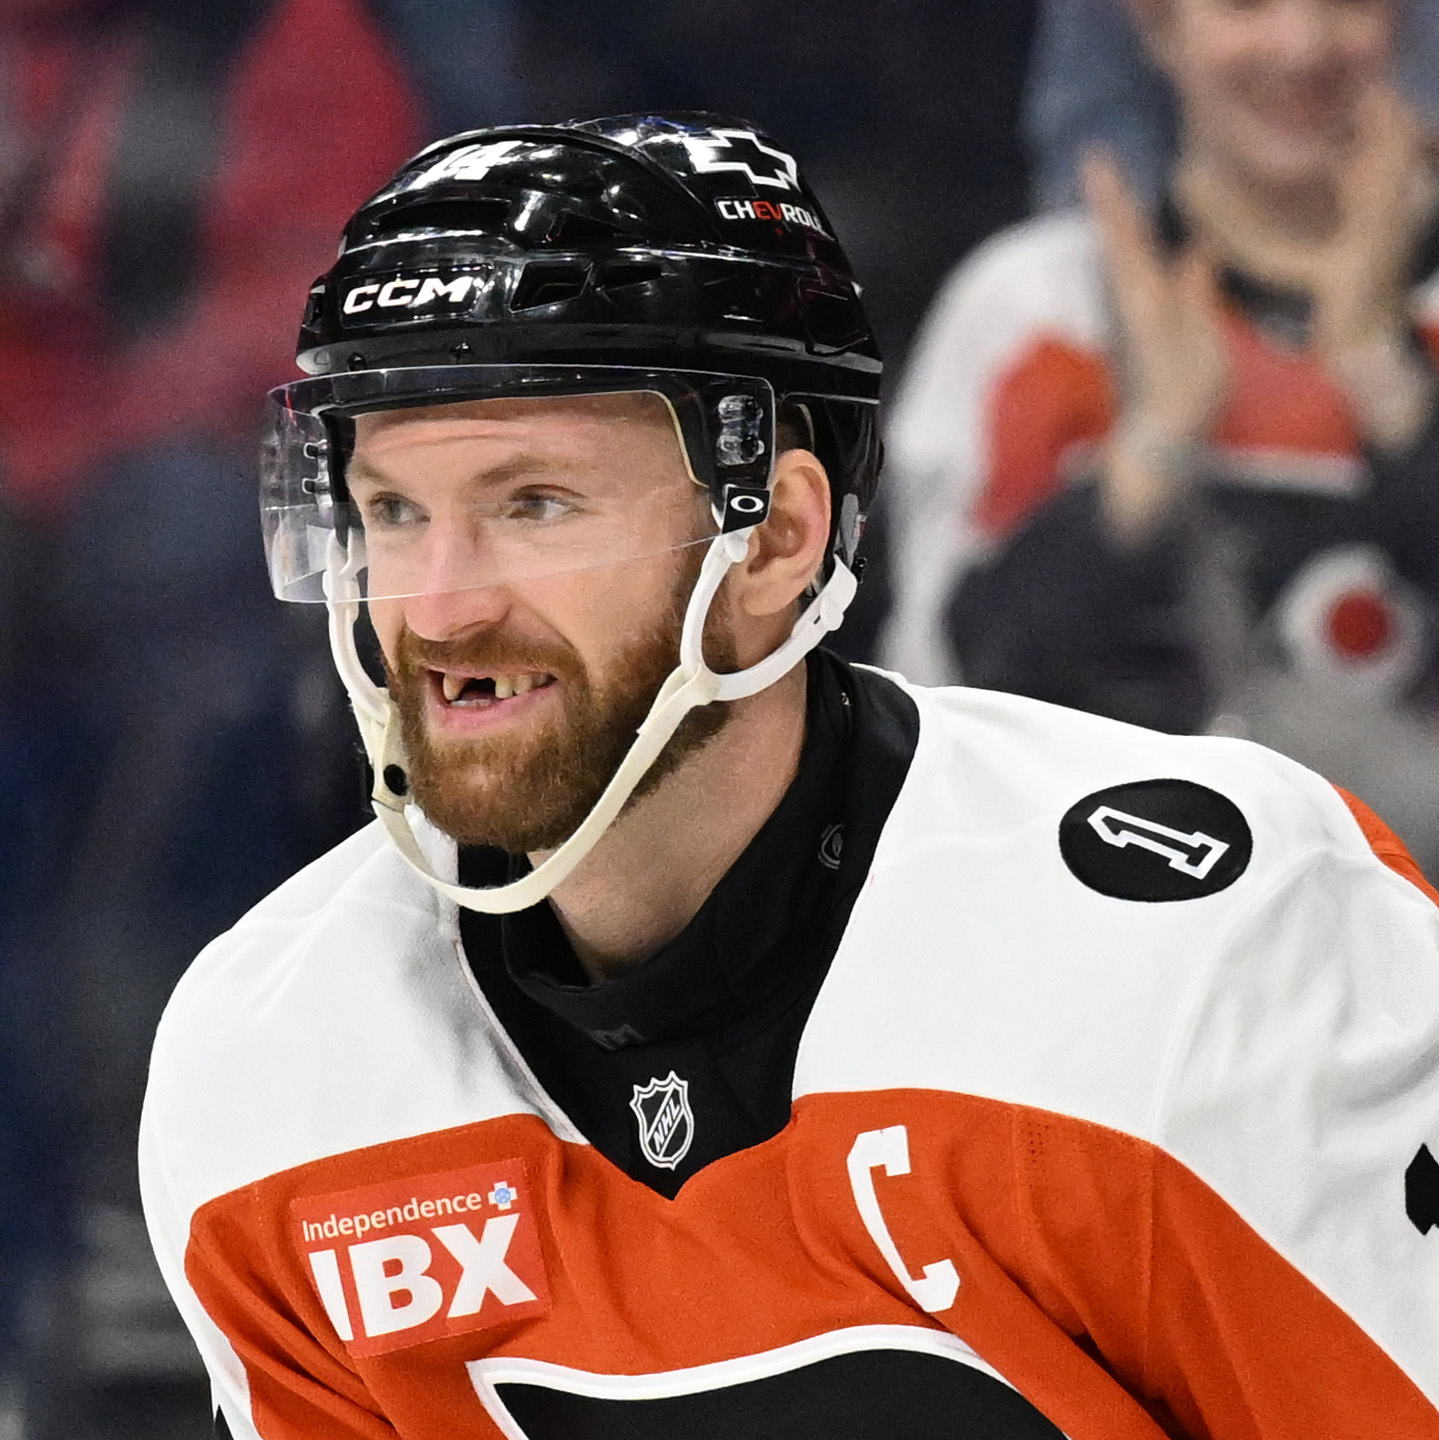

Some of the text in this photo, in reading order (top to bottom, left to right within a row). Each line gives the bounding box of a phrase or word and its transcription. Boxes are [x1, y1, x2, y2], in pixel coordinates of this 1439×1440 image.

[717, 200, 823, 231] CHEVROL
[343, 277, 474, 315] CCM
[1088, 806, 1229, 880] 1
[653, 1098, 680, 1153] NHL
[302, 1193, 482, 1242] Independence
[847, 1125, 960, 1314] C
[308, 1213, 538, 1341] IBX
